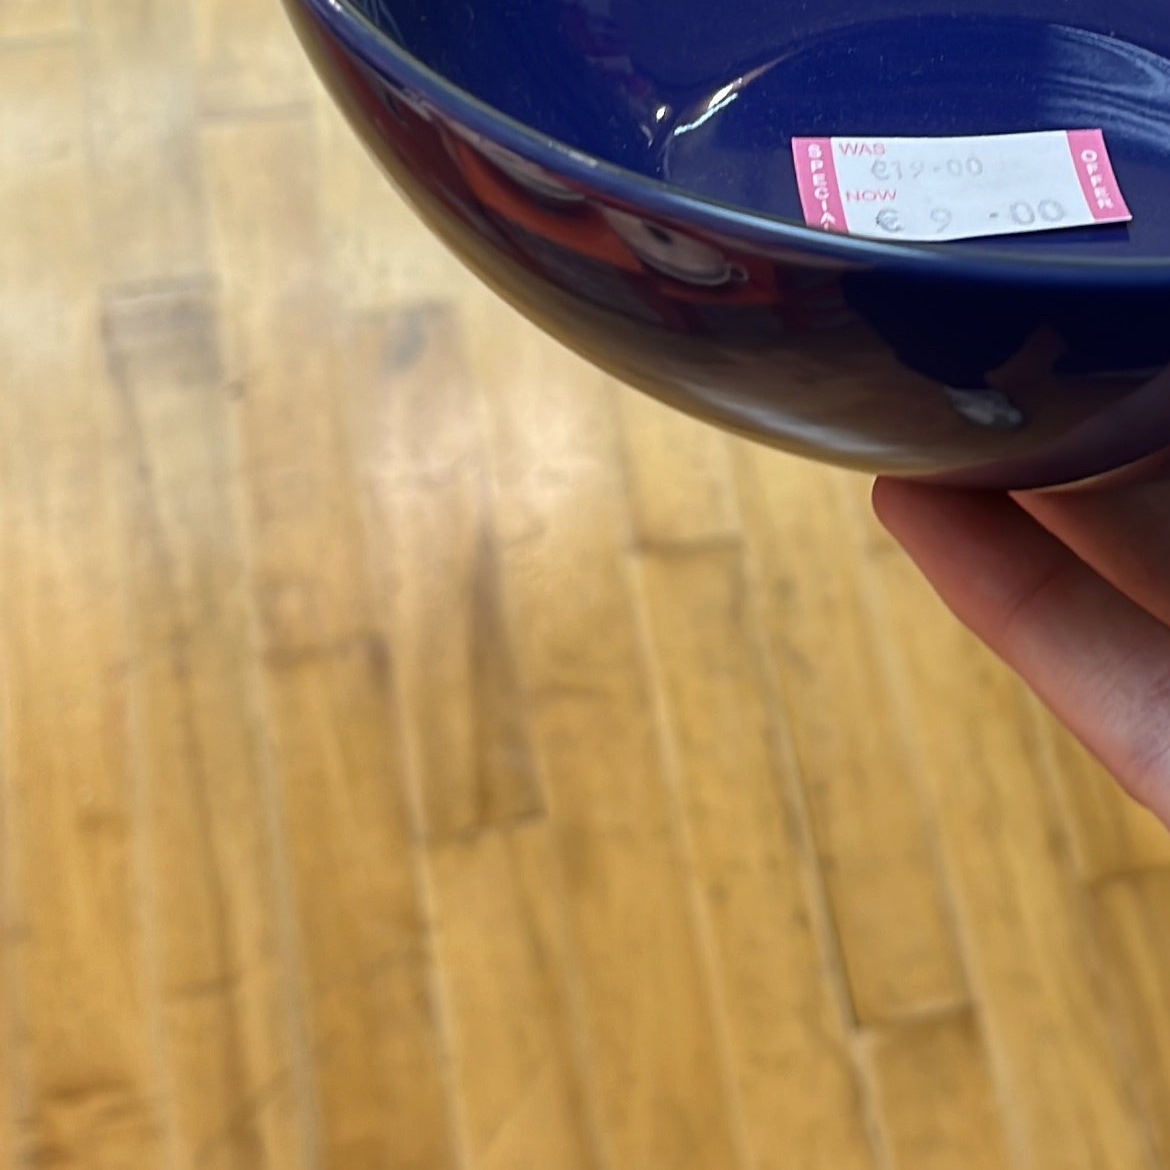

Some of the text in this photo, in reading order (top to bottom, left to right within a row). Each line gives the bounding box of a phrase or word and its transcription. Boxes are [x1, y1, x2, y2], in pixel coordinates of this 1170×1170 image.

[838, 142, 886, 157] WAS
[1080, 149, 1114, 210] OFFER
[845, 189, 898, 203] NOW
